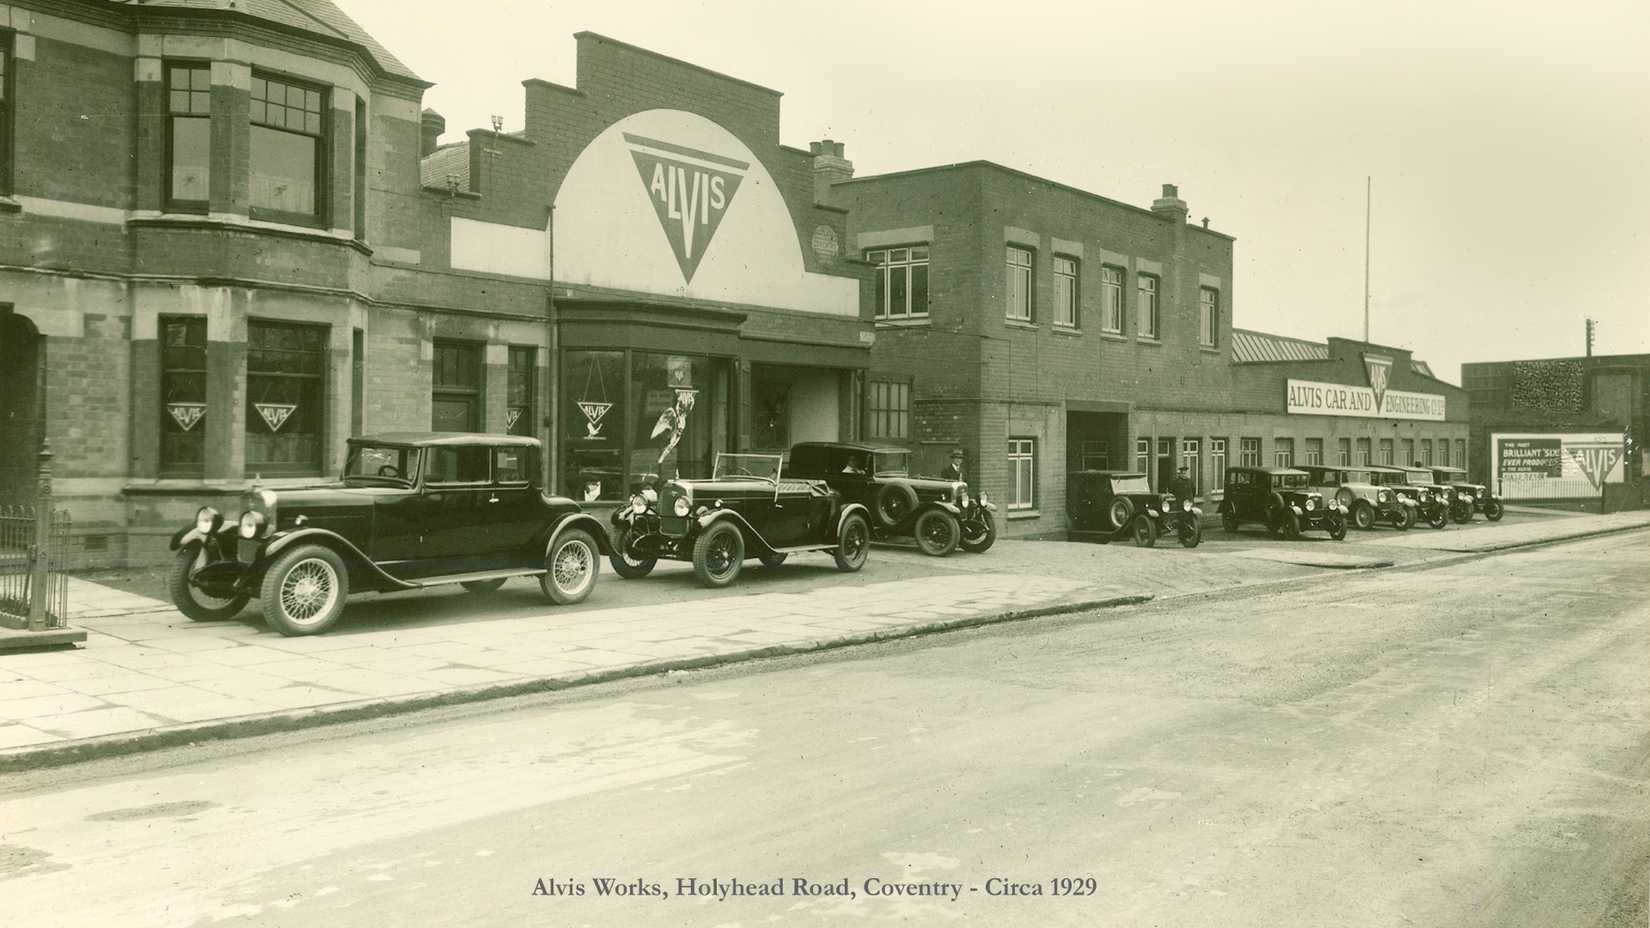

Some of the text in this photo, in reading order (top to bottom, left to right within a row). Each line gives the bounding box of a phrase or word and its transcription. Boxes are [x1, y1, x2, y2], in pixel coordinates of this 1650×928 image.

[650, 161, 726, 259] ALVIS
[1371, 363, 1386, 402] ALVIS
[1288, 385, 1372, 412] ALVIS CAR AND
[1386, 394, 1431, 415] ENGINEERING
[173, 407, 200, 424] ALVIS
[263, 407, 287, 424] ALVIS
[585, 405, 605, 419] ALVIS
[1503, 448, 1541, 458] BRILLIANT
[1502, 459, 1522, 467] EVER
[1577, 449, 1616, 486] ALVIS
